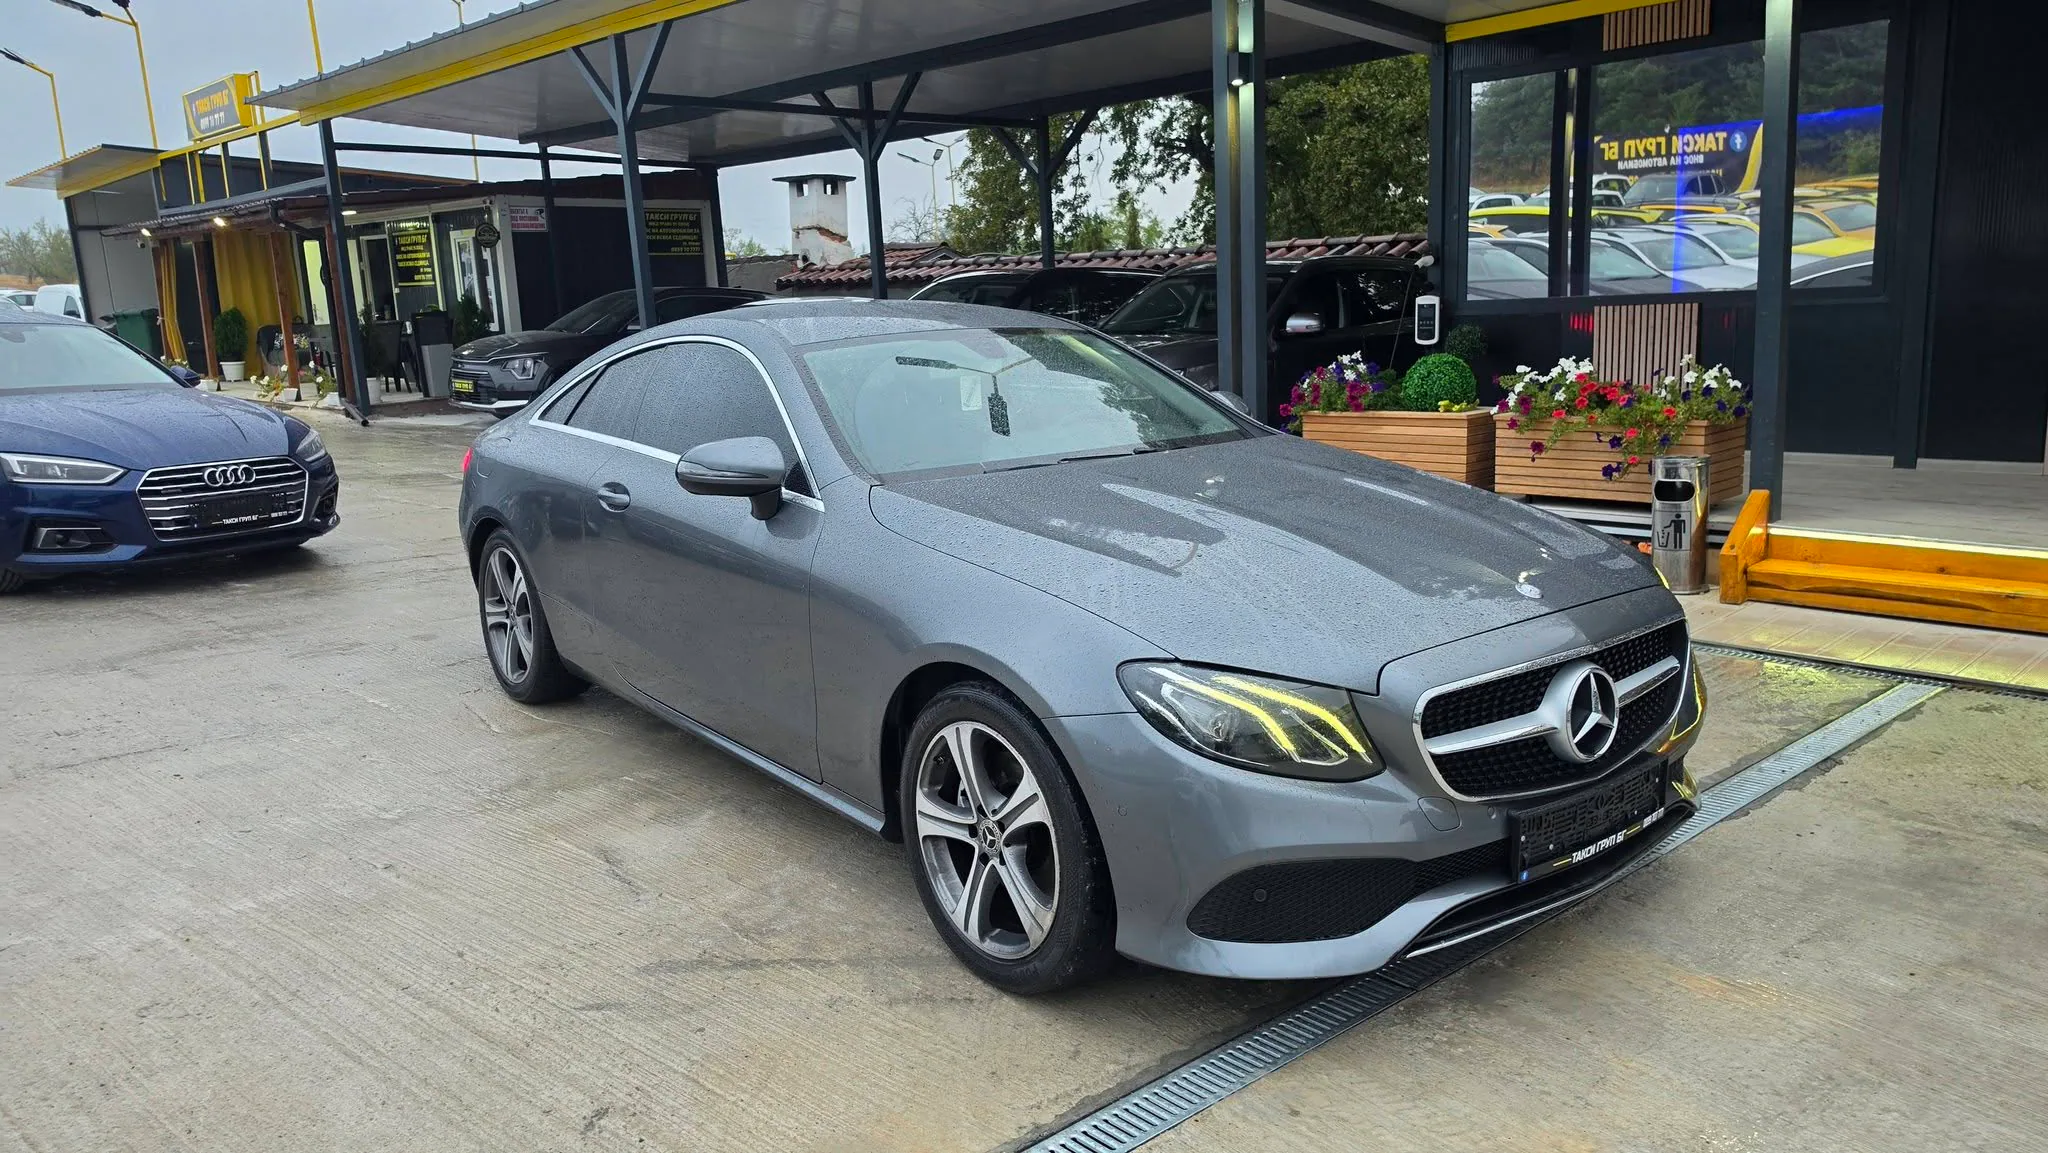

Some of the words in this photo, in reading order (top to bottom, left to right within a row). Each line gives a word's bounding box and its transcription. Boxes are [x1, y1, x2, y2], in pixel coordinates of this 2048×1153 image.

[210, 92, 223, 109] ГРУП
[1572, 843, 1597, 864] ТАКСИ
[1596, 834, 1616, 853] ГРУП
[1616, 828, 1628, 843] БГ
